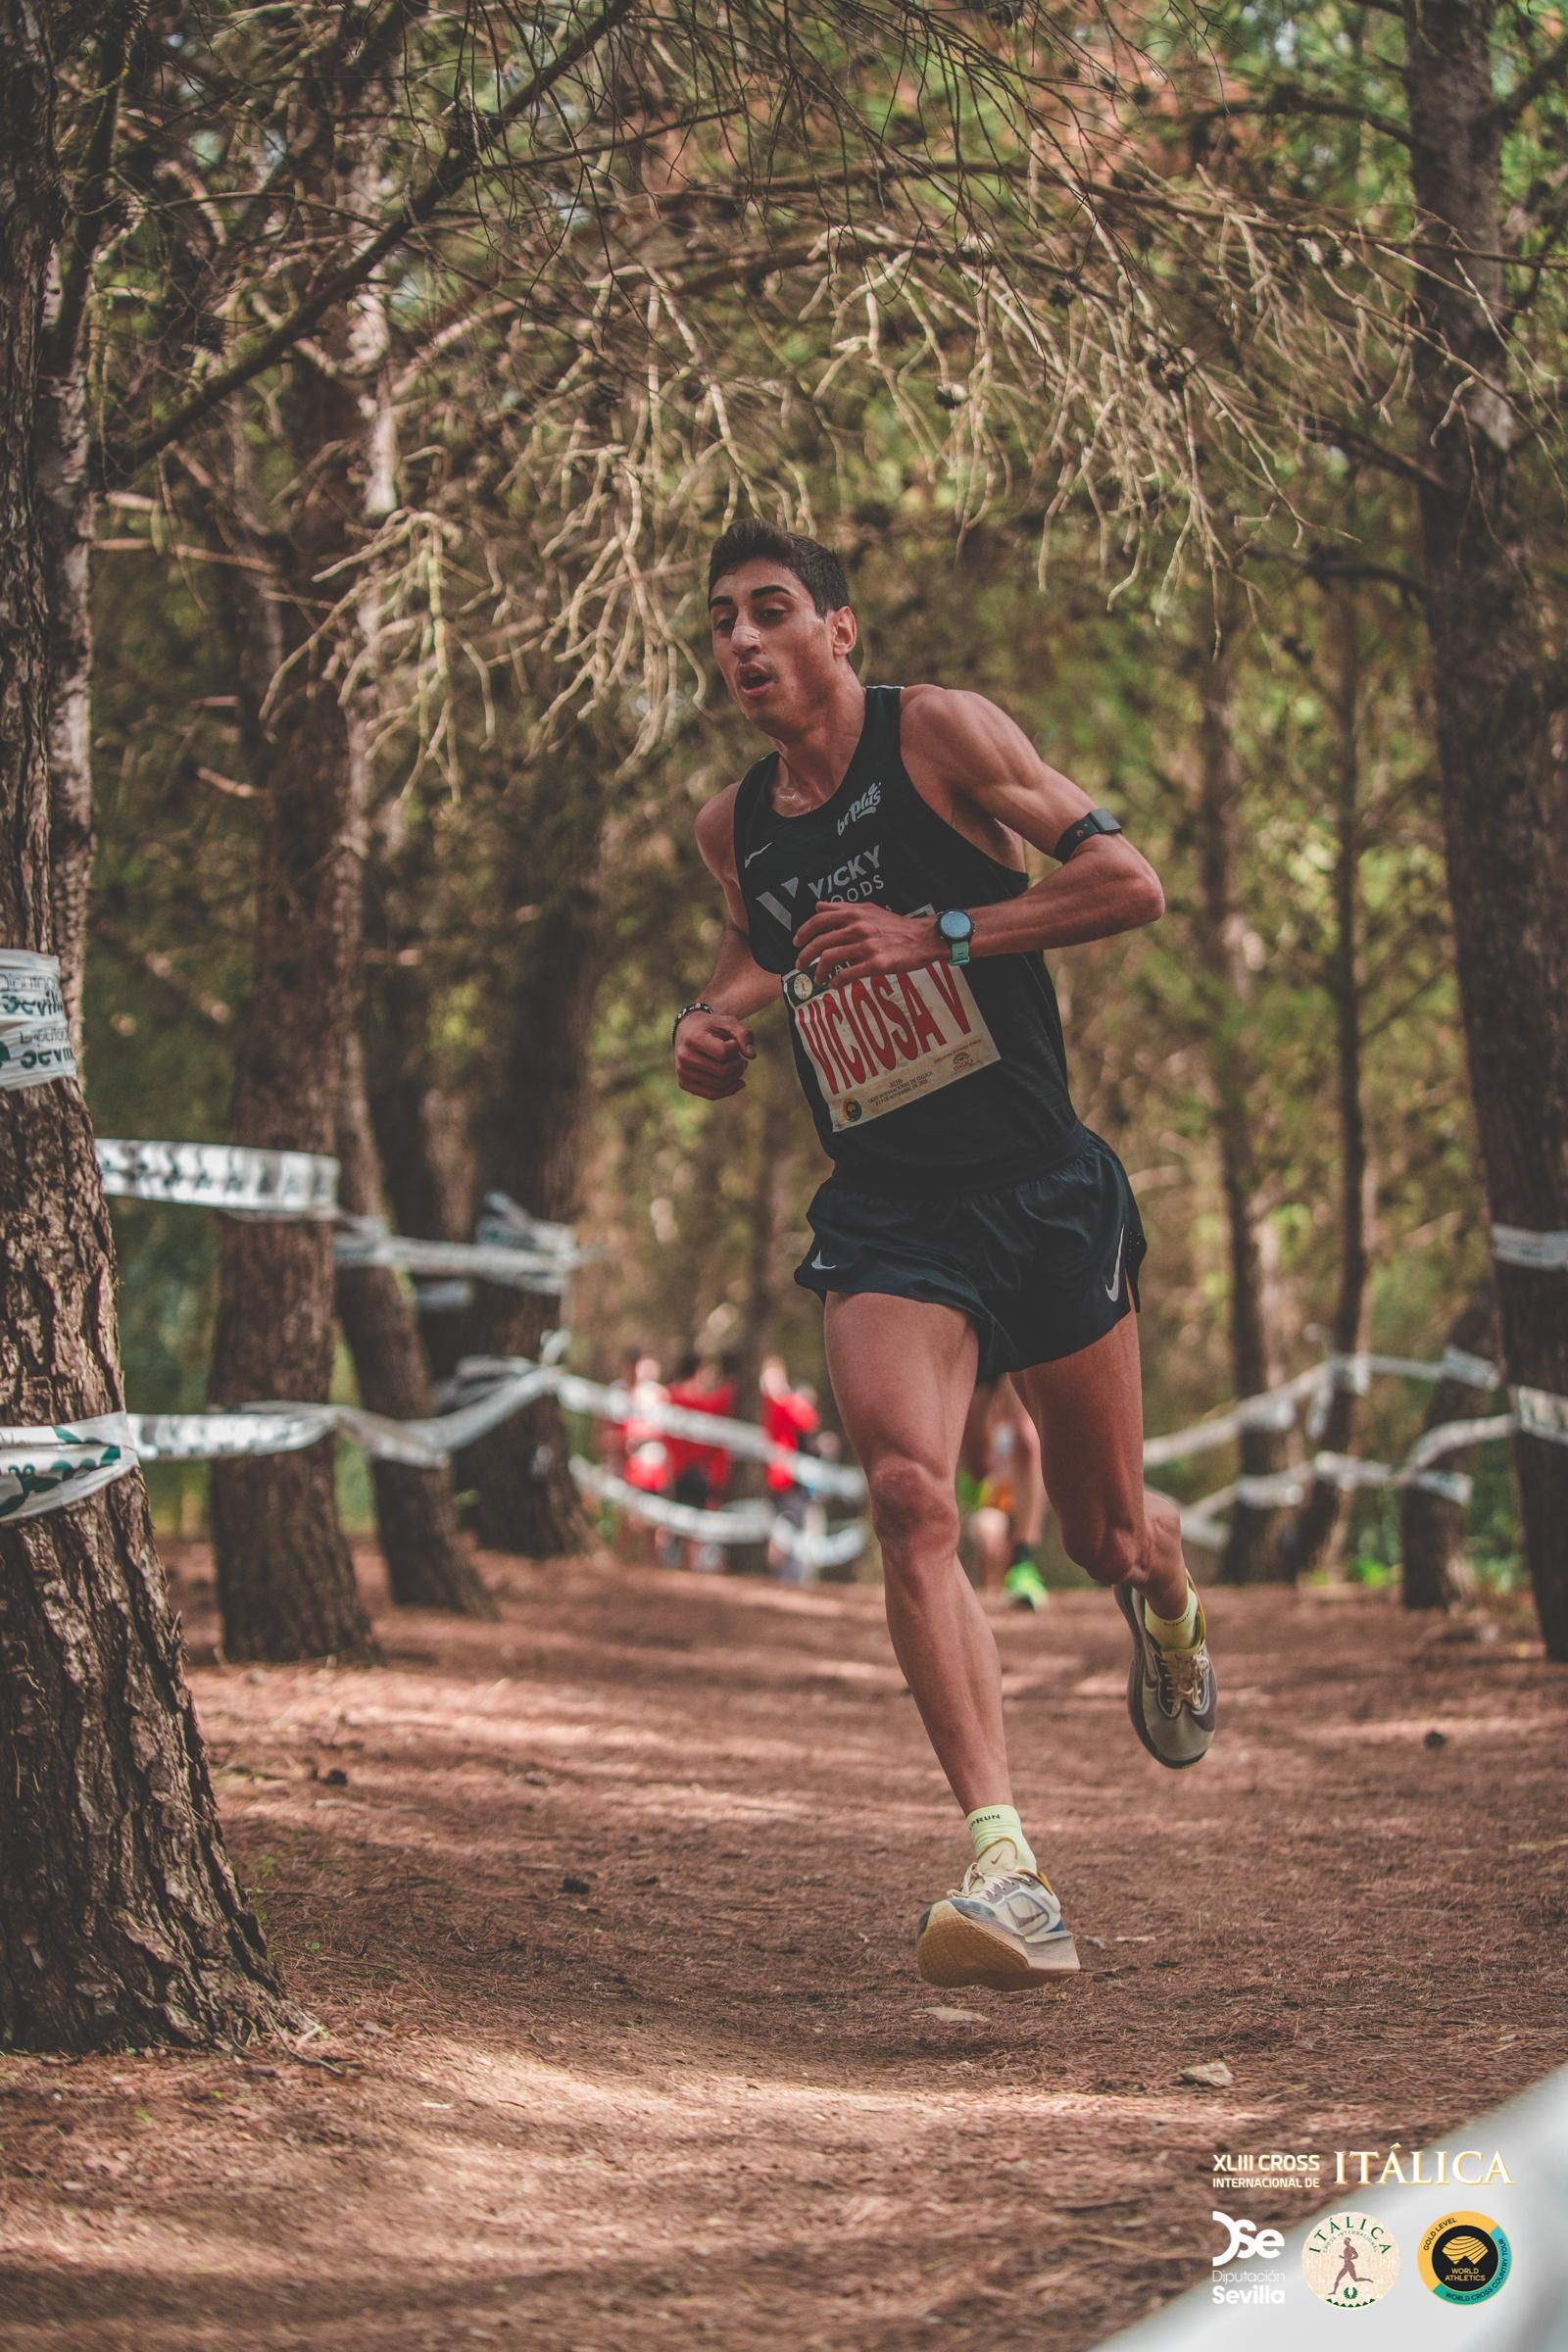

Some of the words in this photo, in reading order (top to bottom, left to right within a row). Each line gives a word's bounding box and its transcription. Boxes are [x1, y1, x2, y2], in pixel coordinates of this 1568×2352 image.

[807, 844, 881, 900] VICKY
[829, 874, 884, 904] OODS
[798, 970, 948, 1096] VICIOSA
[925, 959, 972, 1035] V
